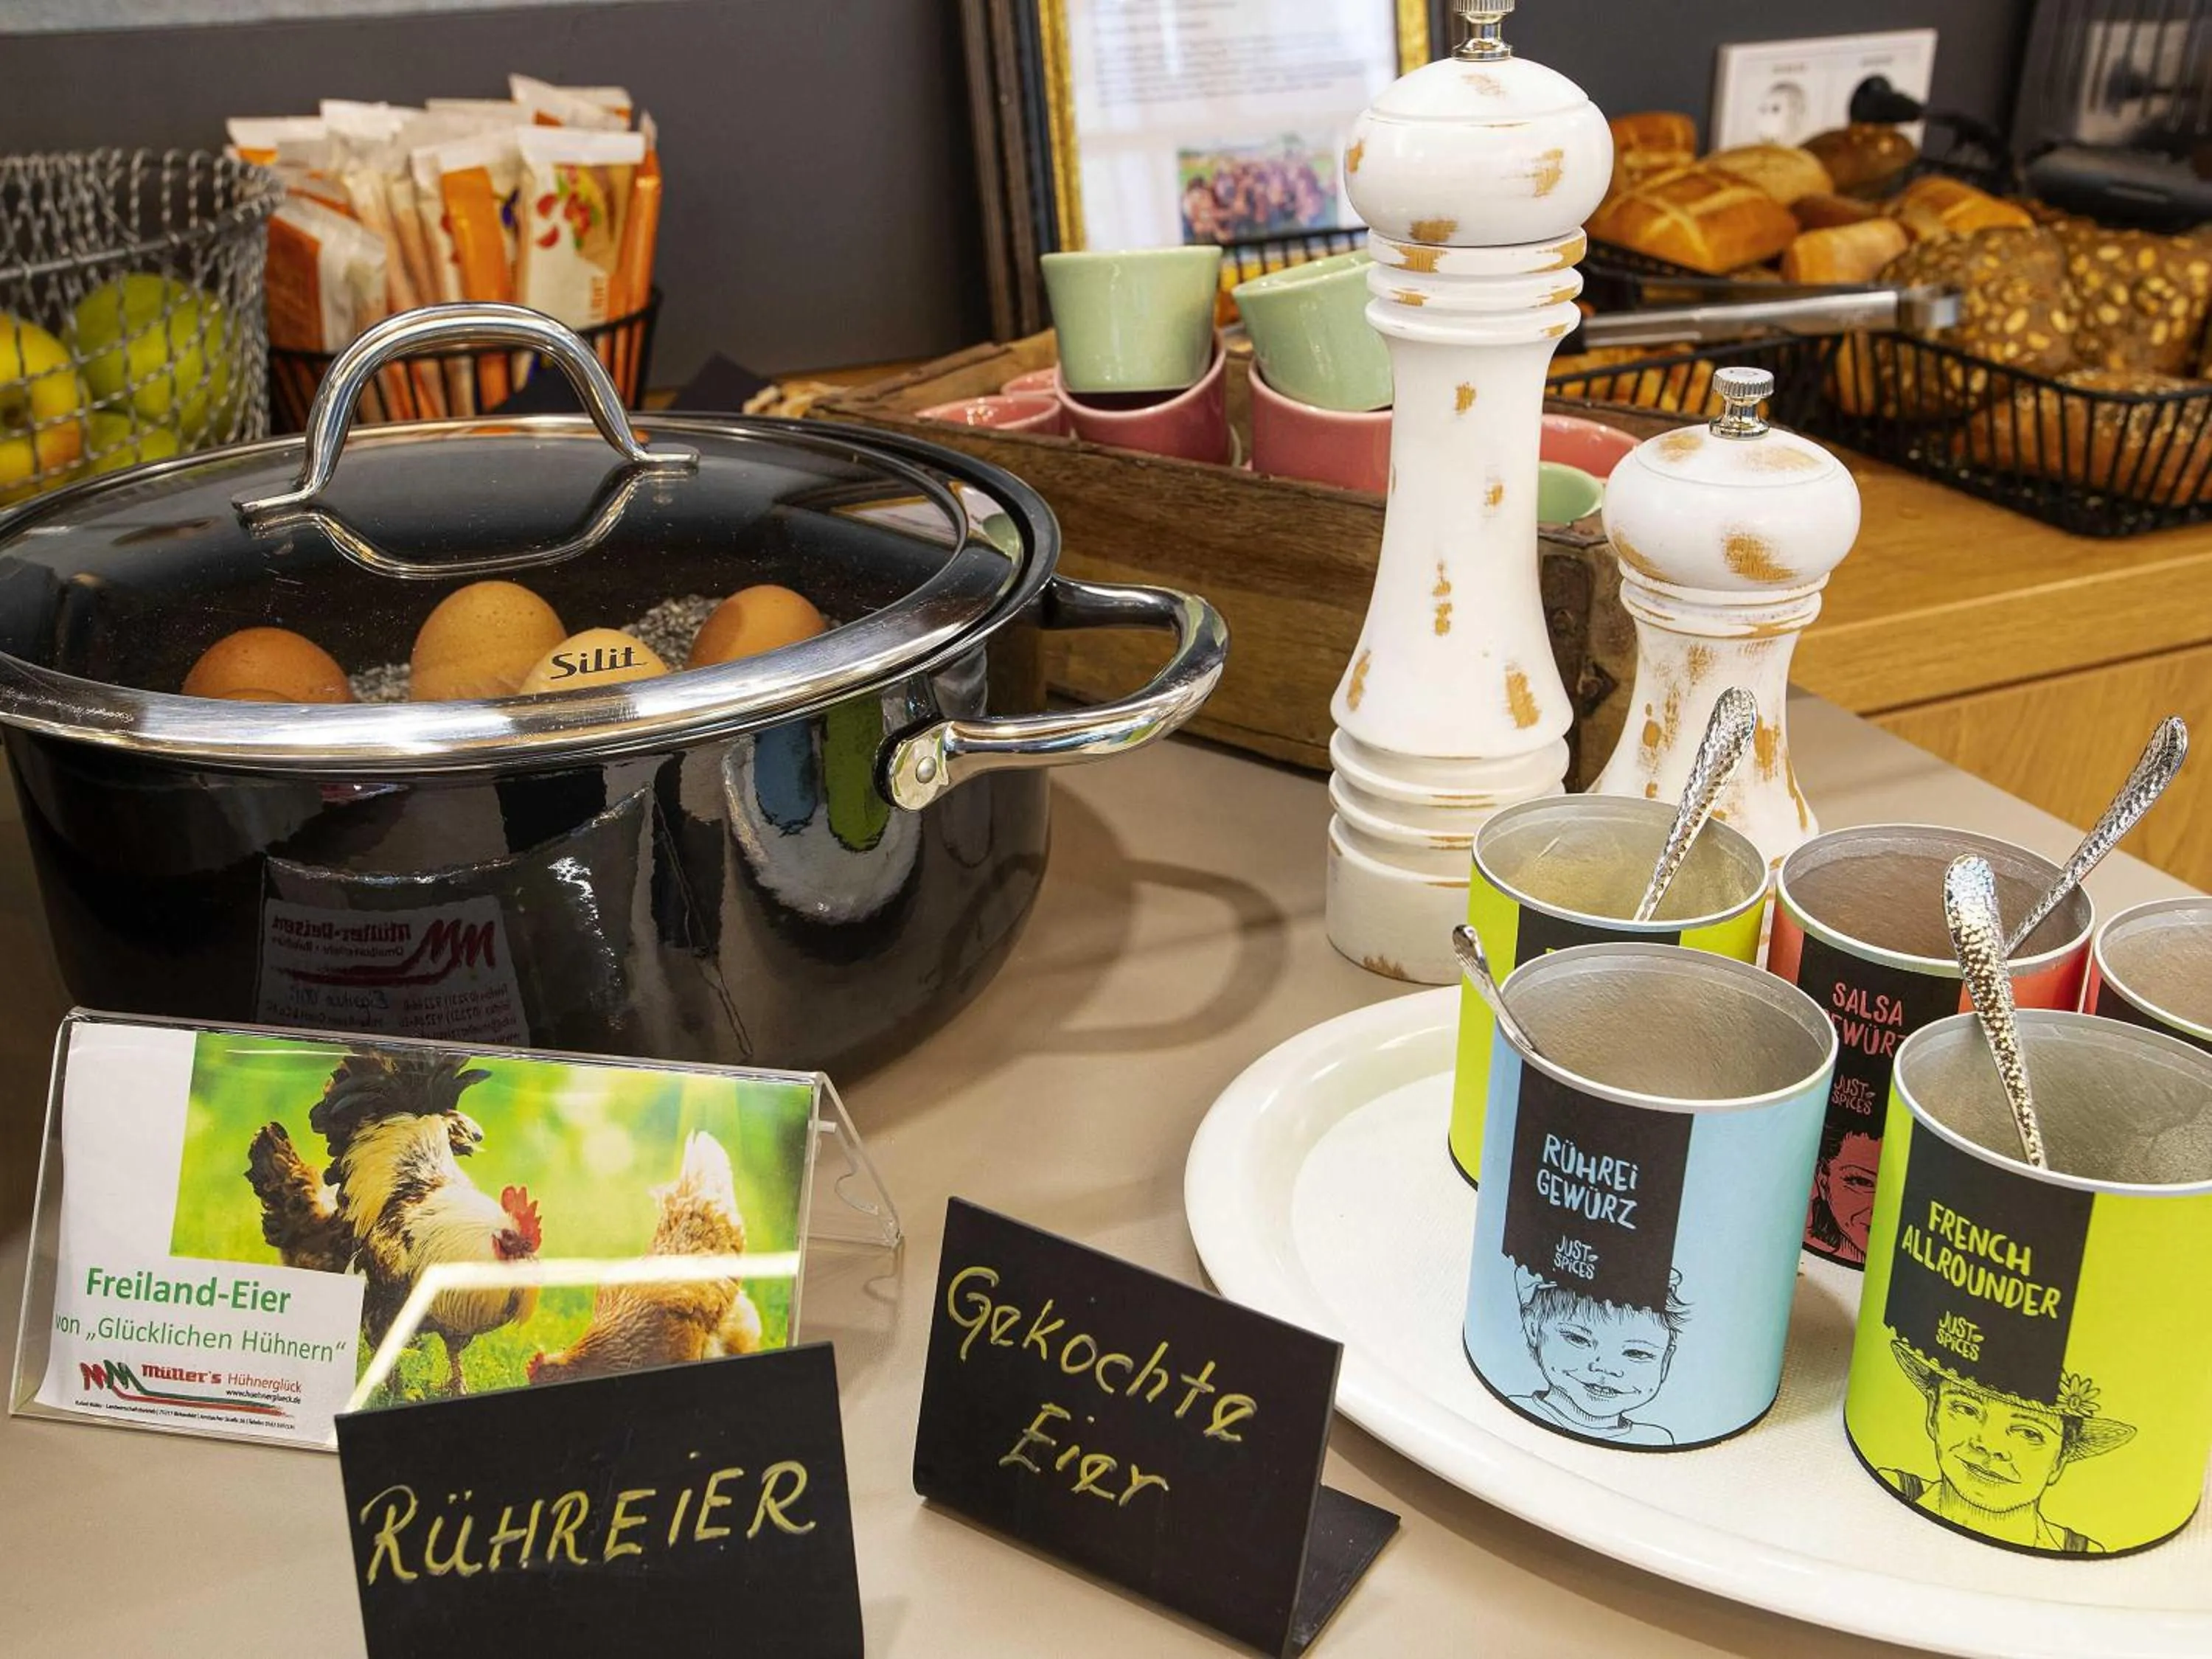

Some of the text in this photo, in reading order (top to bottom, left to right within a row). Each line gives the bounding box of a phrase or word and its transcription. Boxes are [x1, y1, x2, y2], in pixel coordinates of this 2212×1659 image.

[550, 646, 648, 680] Silit
[1832, 982, 1903, 1026] SALSA
[1824, 1009, 1907, 1058] WÜR
[1834, 1075, 1869, 1098] JUST
[1537, 1169, 1638, 1230] GEWÜRZ
[1556, 1235, 1592, 1262] JUST
[1928, 1200, 2031, 1276] FRENCH
[86, 1267, 291, 1313] Freiland-Eier
[1902, 1224, 2062, 1319] ALLROUNDER
[56, 1313, 80, 1335] von
[1939, 1311, 1981, 1340] JUST
[948, 1265, 1258, 1441] Gekochte
[226, 1390, 302, 1404] www.huehnerglueck.de
[228, 1373, 302, 1393] Hühnerglück
[999, 1403, 1169, 1506] Eier
